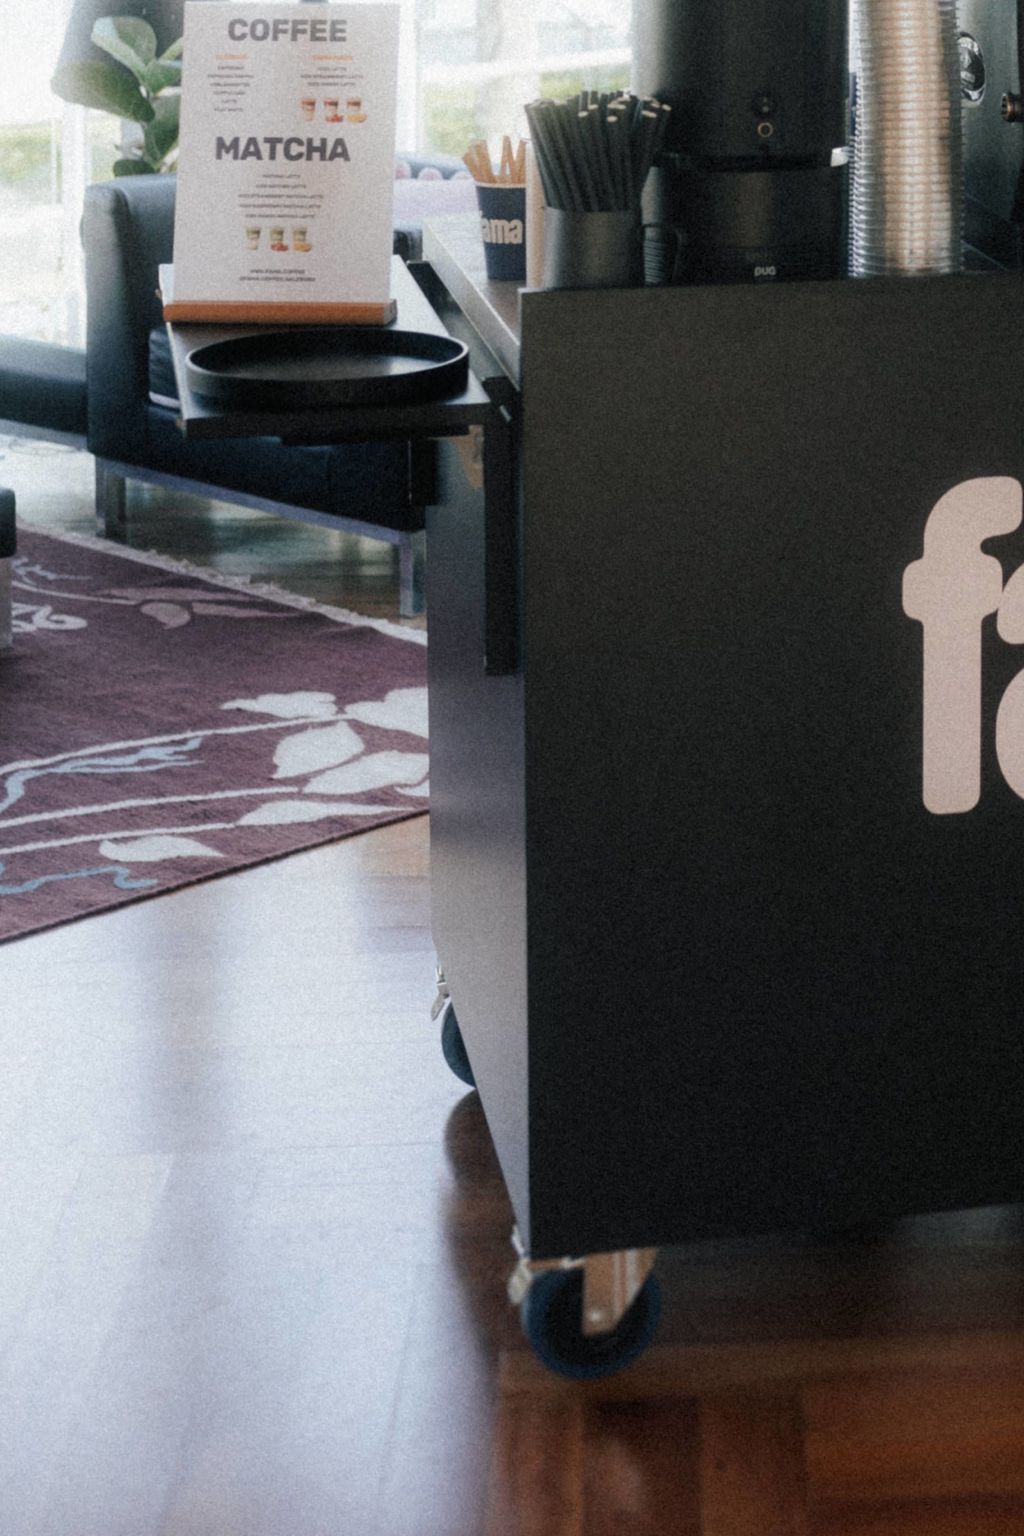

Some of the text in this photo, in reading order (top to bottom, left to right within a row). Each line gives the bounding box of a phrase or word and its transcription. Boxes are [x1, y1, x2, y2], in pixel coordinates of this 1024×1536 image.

[228, 18, 348, 42] COFFEE
[215, 136, 351, 161] MATCHA
[480, 210, 523, 245] ama
